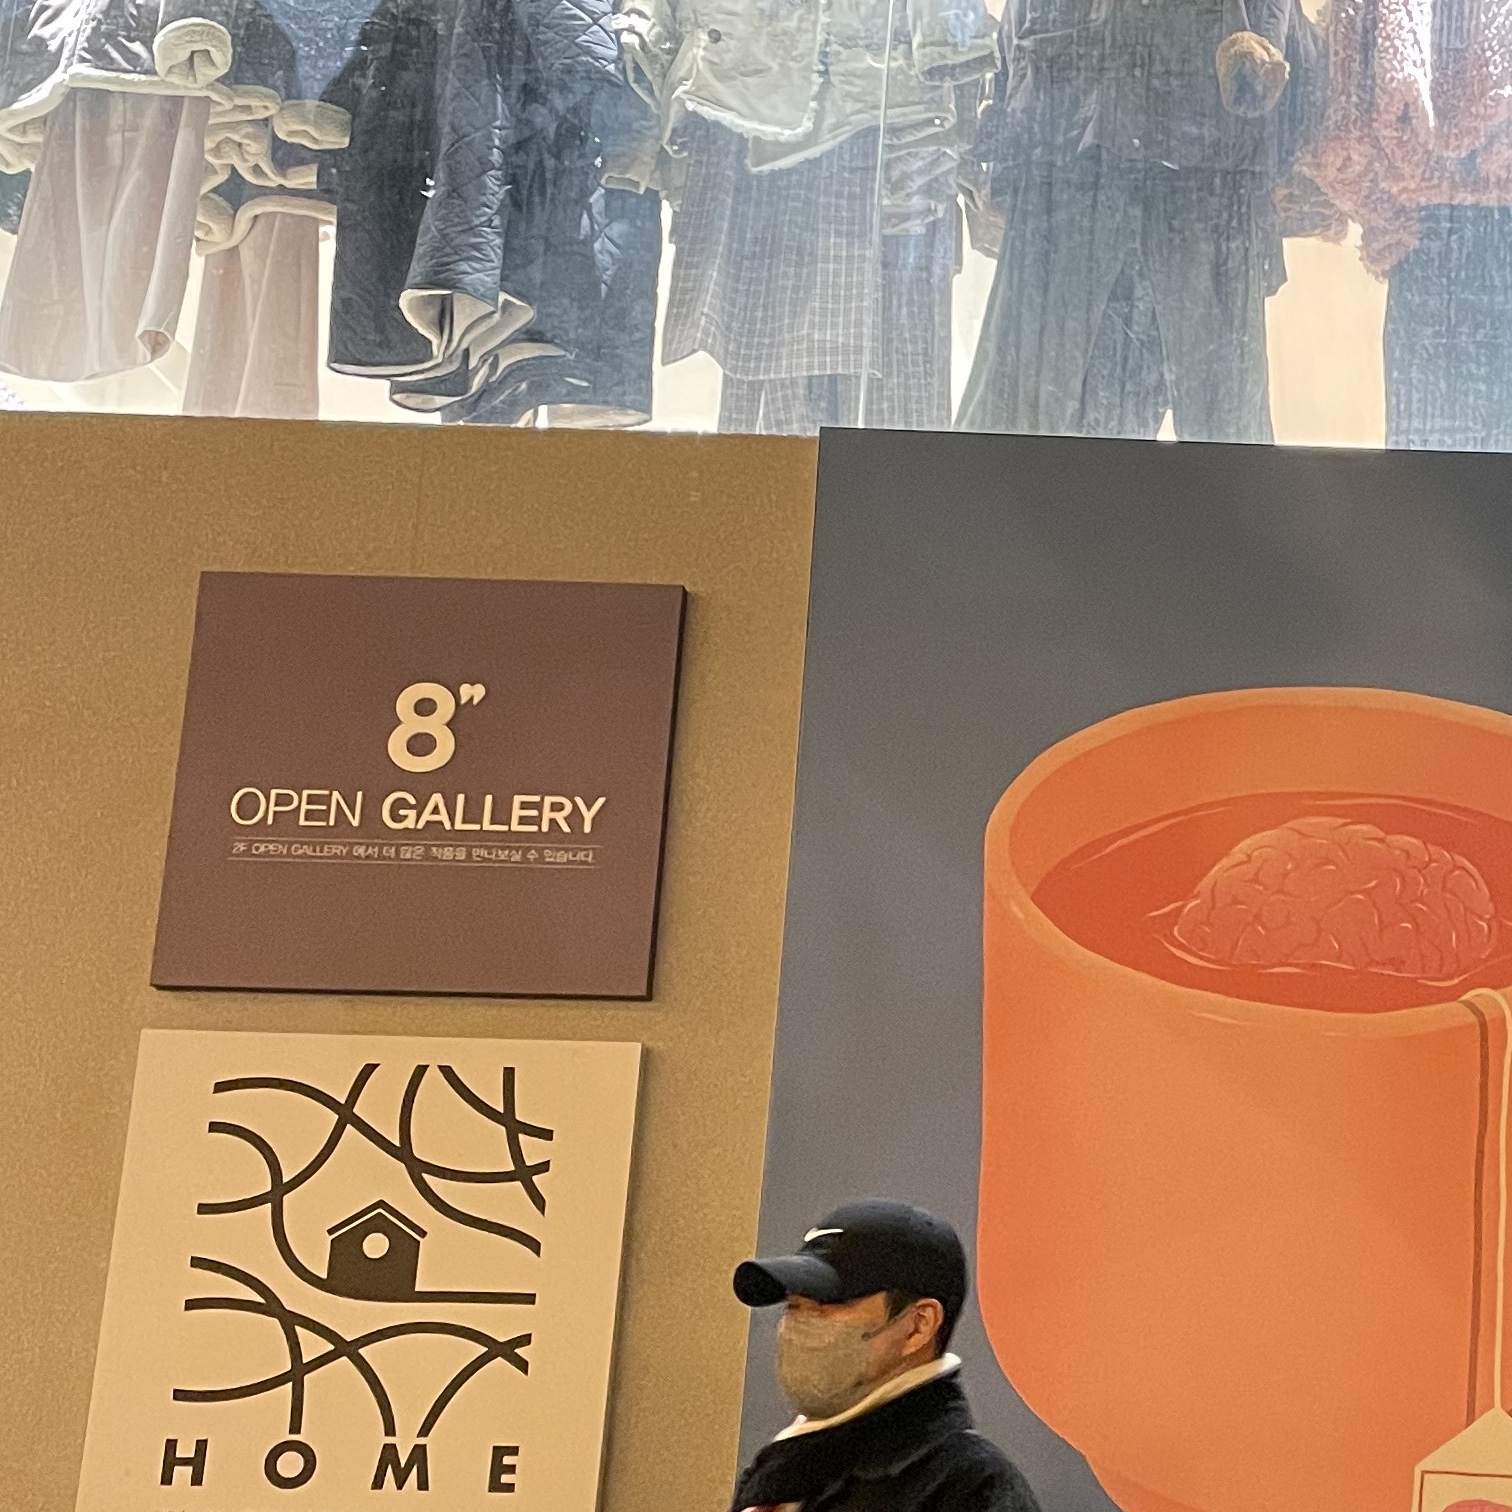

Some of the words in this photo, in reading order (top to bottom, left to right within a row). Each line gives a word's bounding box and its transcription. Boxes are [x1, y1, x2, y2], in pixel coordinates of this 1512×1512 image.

[230, 787, 363, 827] OPEN
[381, 791, 606, 834] GALLERY
[232, 842, 248, 854] 2F
[251, 843, 288, 855] OPEN
[291, 843, 349, 857] GALLERY
[352, 844, 378, 859] 에서
[382, 846, 396, 859] 더
[400, 846, 426, 860] 많은
[431, 846, 467, 860] 작품을
[472, 847, 522, 862] 만나보실
[526, 849, 539, 862] 수
